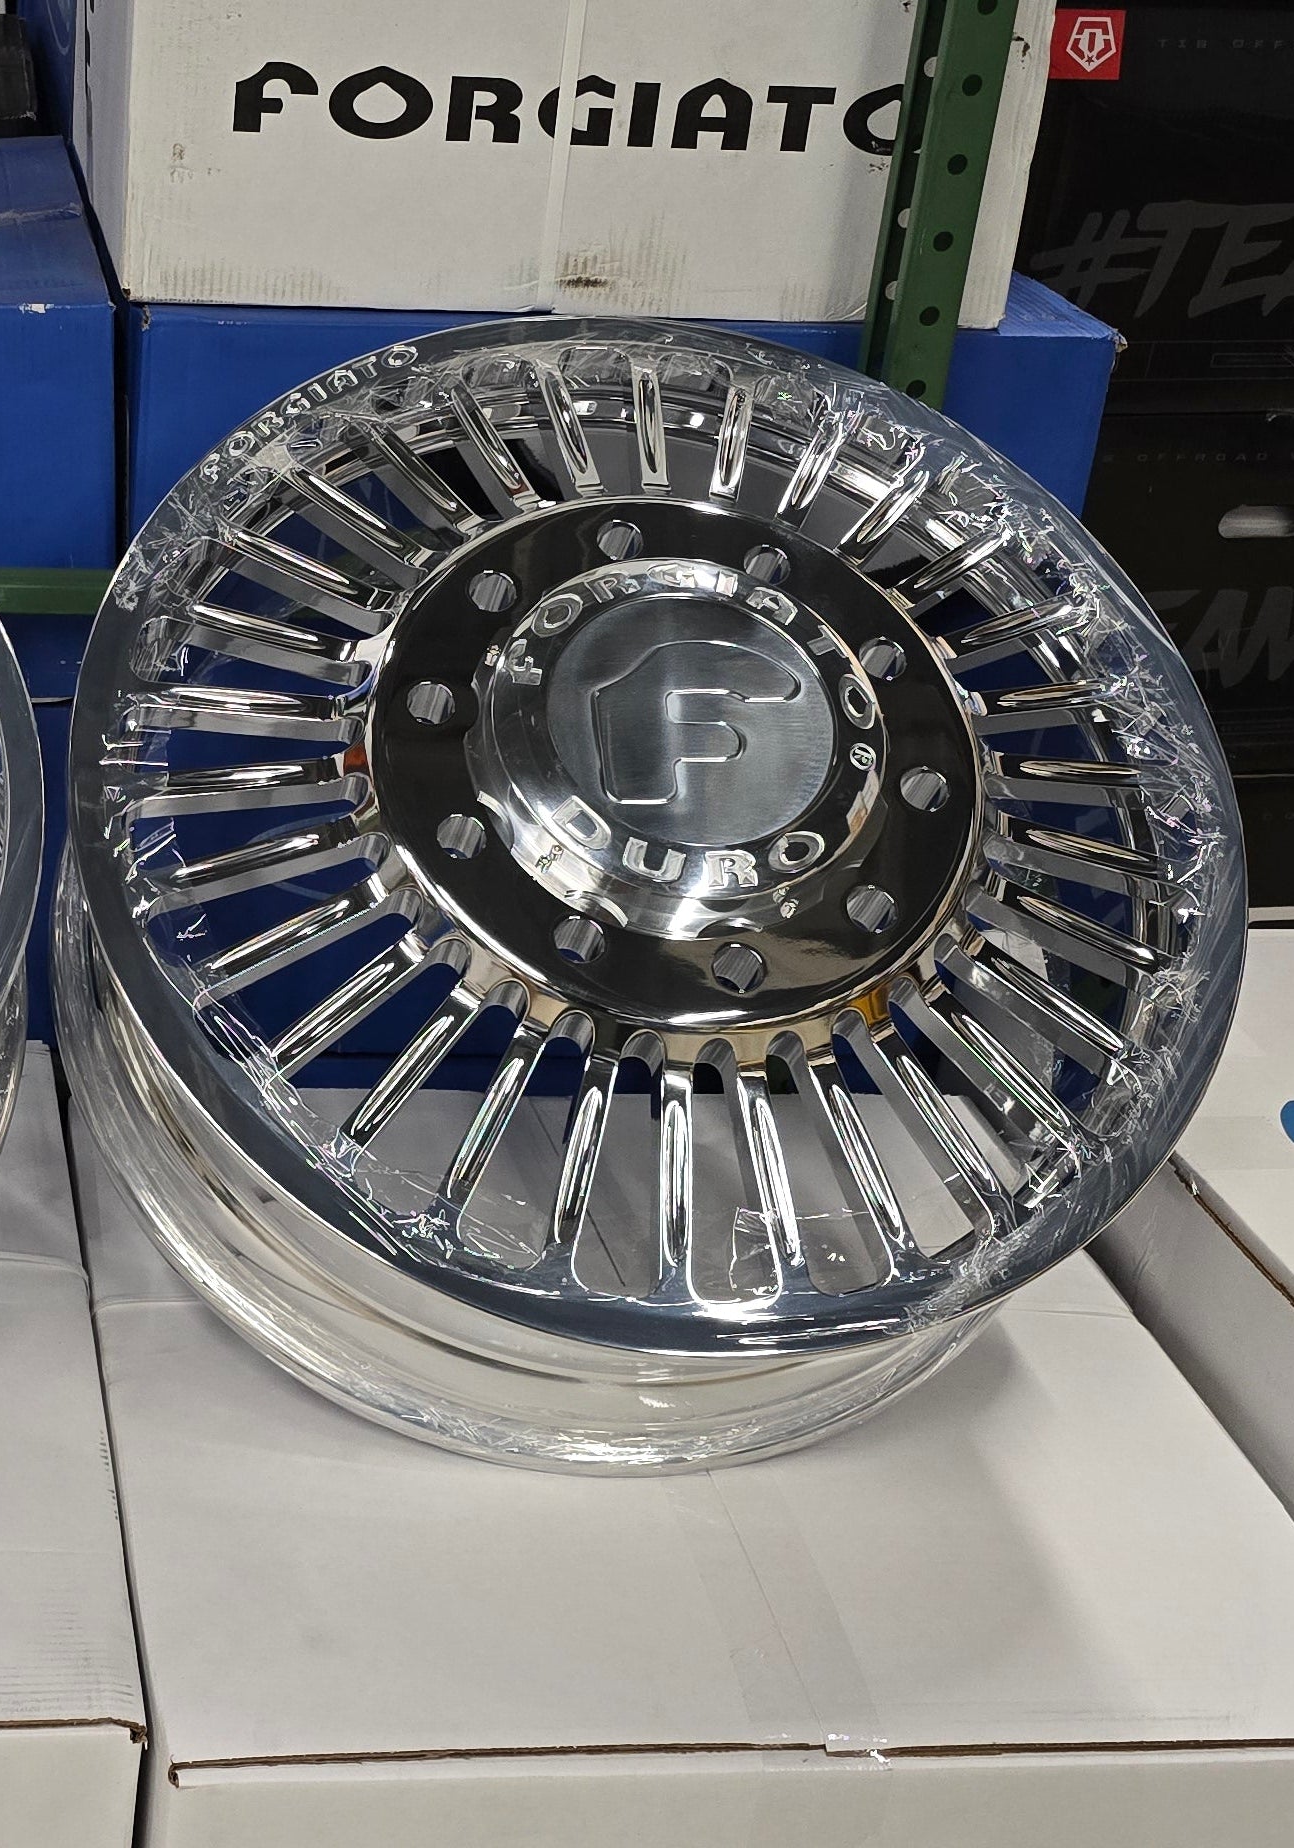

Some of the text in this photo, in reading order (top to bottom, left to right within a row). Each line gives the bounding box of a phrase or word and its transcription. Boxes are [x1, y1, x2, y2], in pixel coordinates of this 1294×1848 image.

[199, 345, 418, 484] FORGIATO
[505, 562, 876, 730] FORGIATO
[551, 795, 825, 887] DURO
